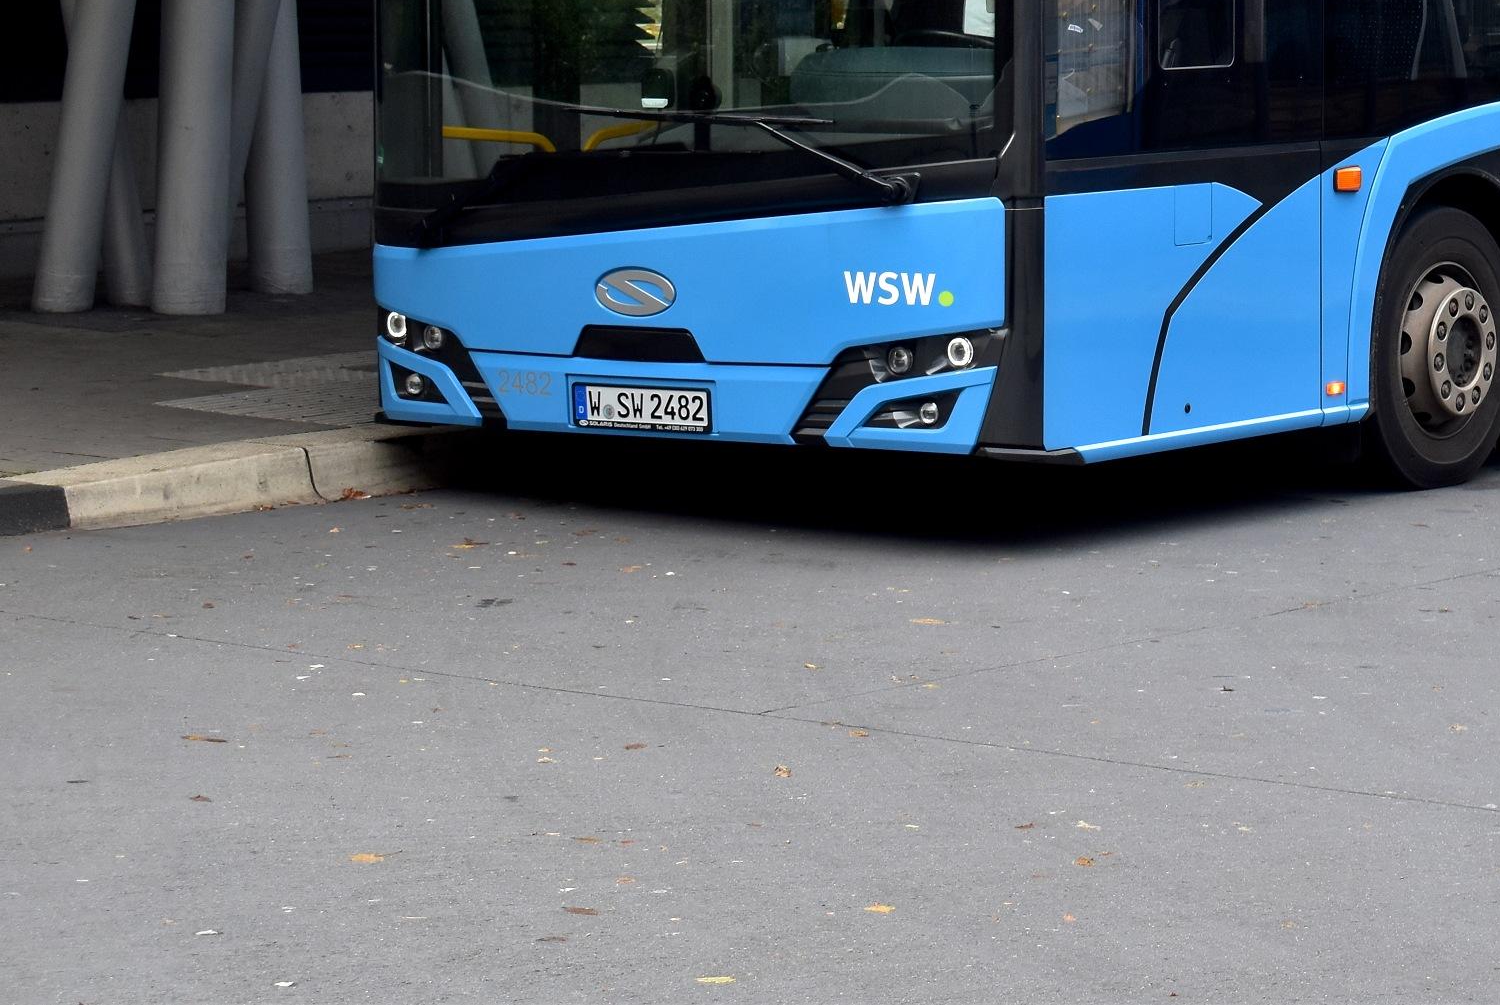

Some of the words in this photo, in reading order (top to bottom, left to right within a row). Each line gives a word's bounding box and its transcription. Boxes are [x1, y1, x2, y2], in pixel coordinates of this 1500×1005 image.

[497, 369, 553, 397] 2482
[578, 405, 585, 414] D
[588, 390, 601, 417] W
[617, 392, 644, 418] SW
[650, 393, 705, 422] 2482
